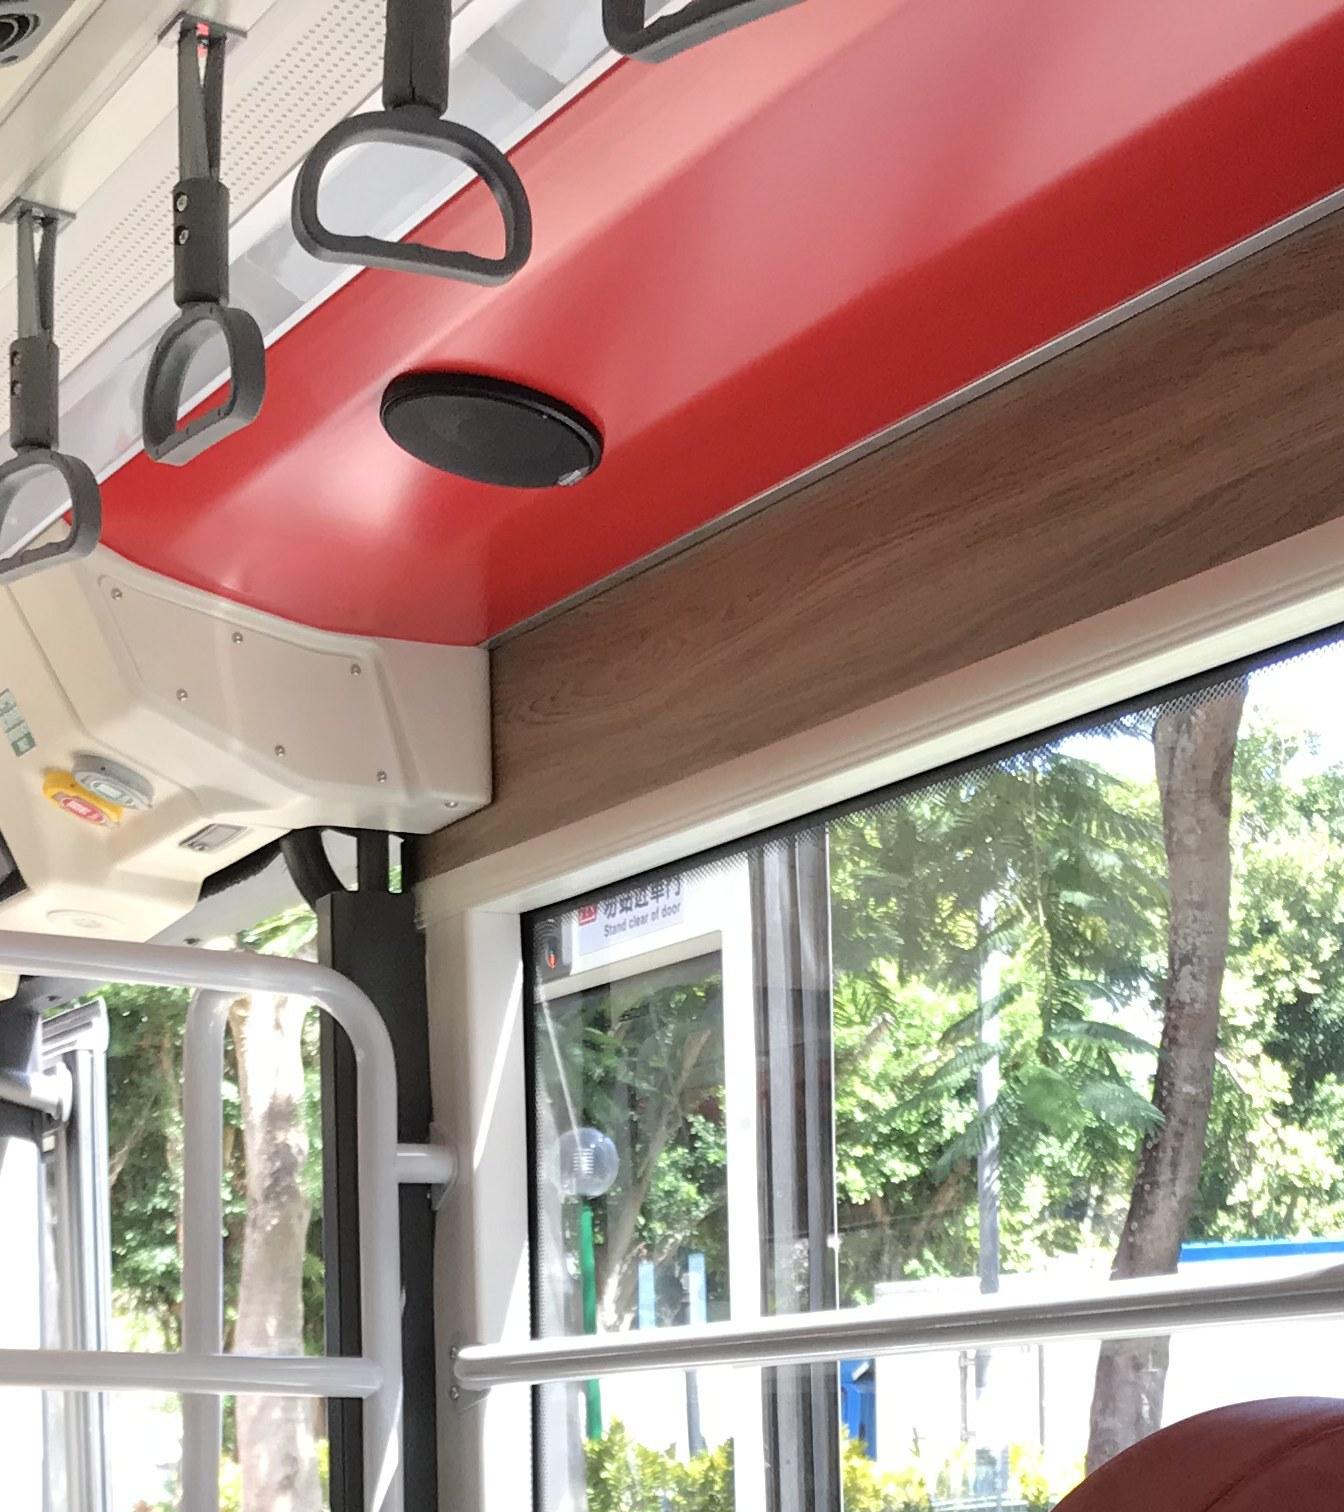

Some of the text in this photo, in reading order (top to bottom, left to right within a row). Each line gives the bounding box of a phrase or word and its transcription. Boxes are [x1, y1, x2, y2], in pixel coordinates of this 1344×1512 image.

[604, 903, 681, 938] Stand clear of door
